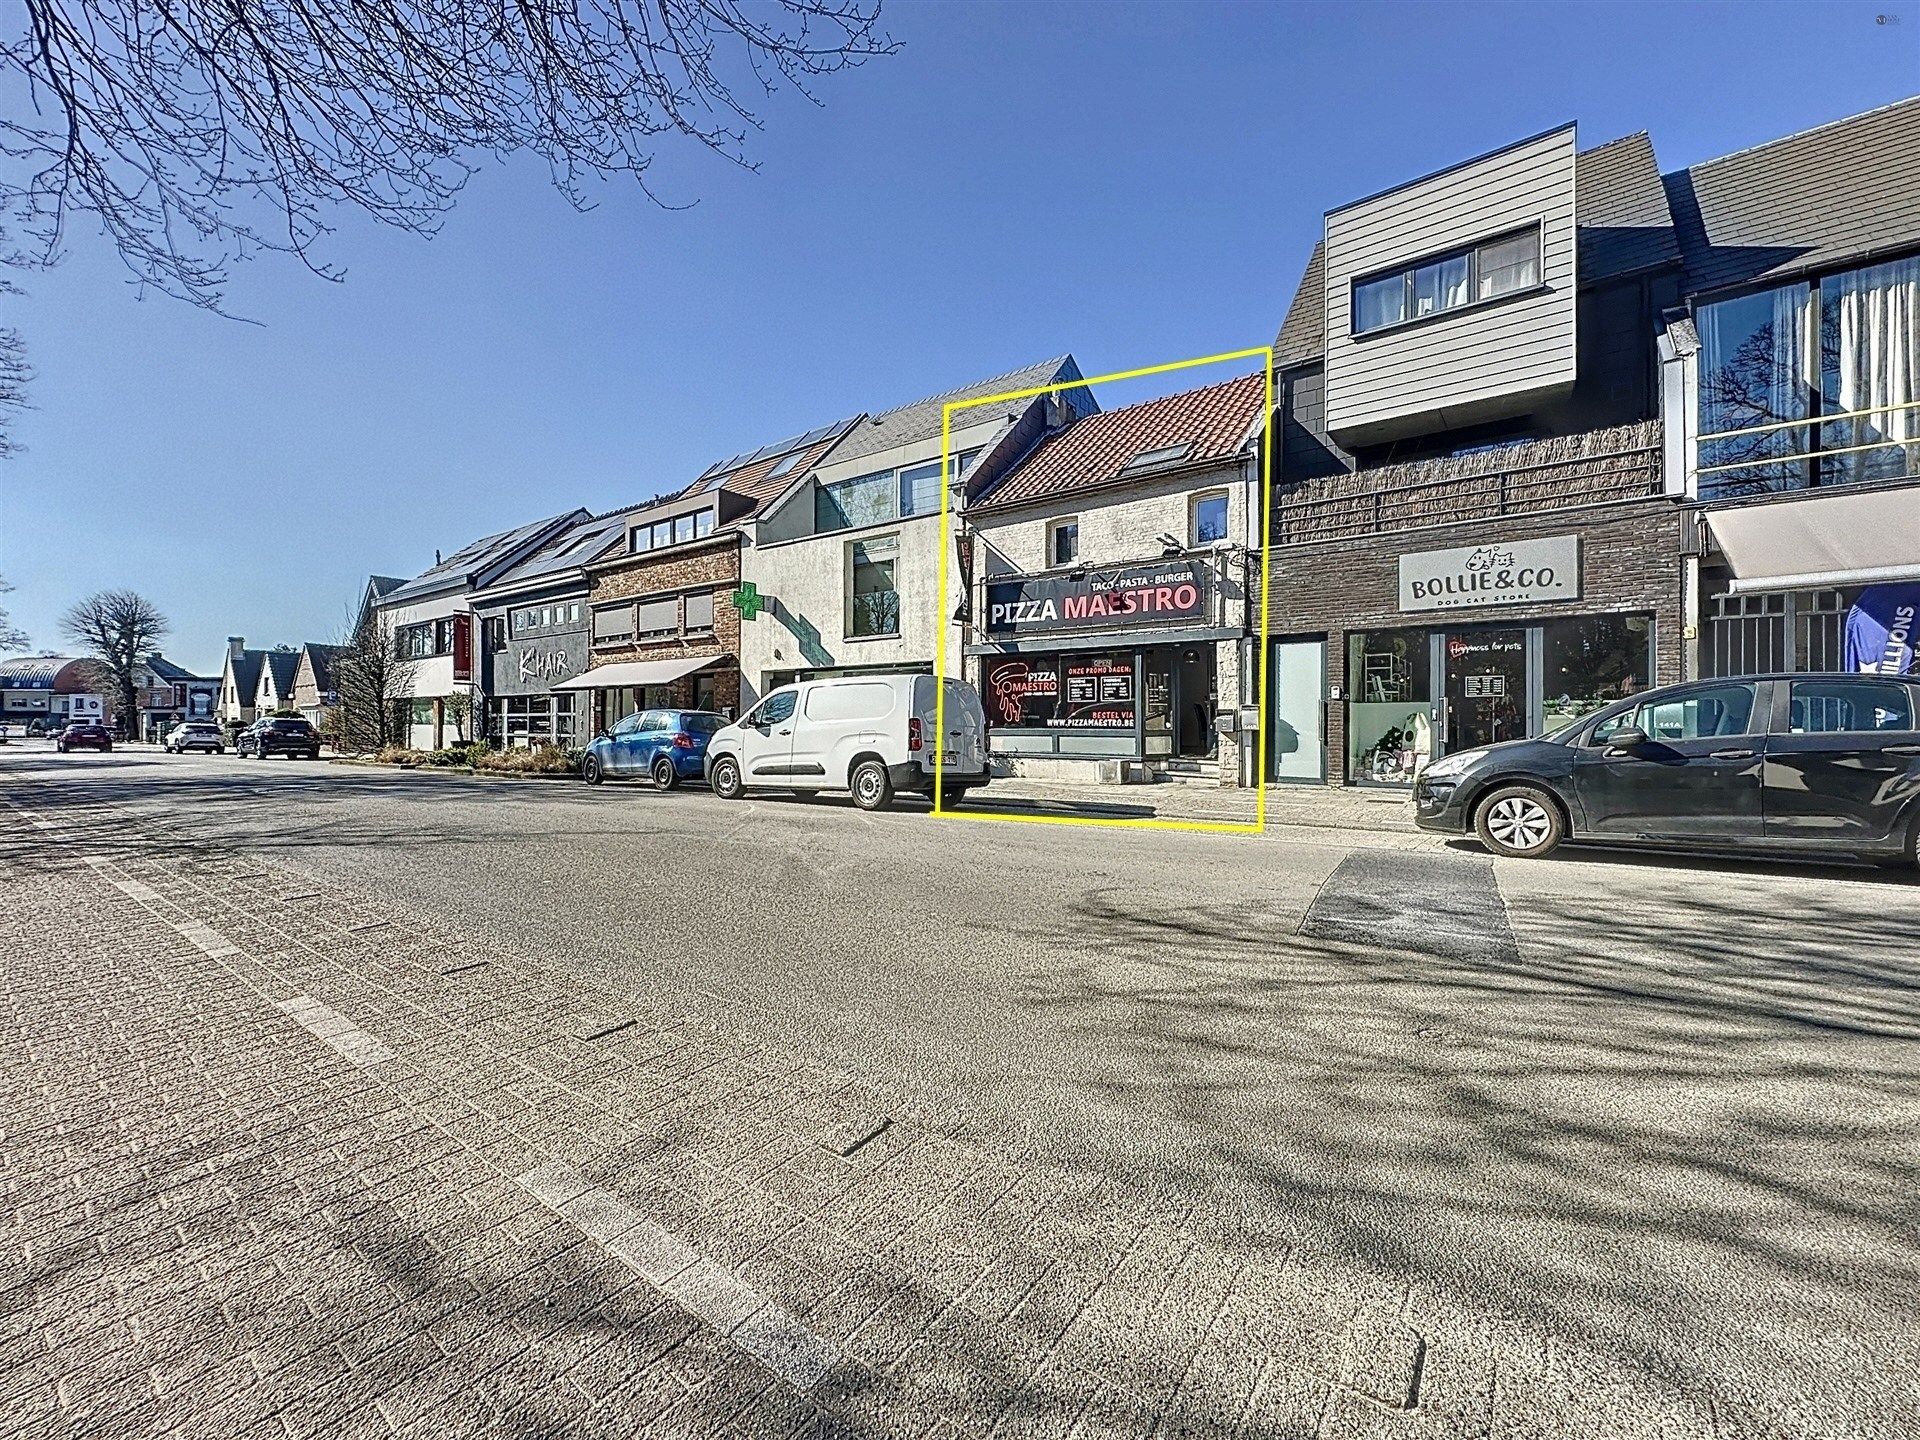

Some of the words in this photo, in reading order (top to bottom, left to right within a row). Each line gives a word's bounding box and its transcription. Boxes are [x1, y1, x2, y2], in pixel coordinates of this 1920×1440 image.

[1091, 581, 1115, 592] TACO
[1120, 578, 1148, 588] PASTA
[1155, 572, 1194, 585] BURGER
[1411, 568, 1563, 599] BOLLIE&CO.
[1493, 594, 1531, 602] STORE
[991, 599, 1058, 625] PIZZA
[1064, 584, 1198, 619] MAESTRO
[1880, 606, 1914, 675] ILLIONS
[1068, 667, 1085, 675] ONZE
[1028, 671, 1057, 682] PIZZA
[1012, 682, 1057, 691] MAESTRO
[1092, 711, 1120, 719] BESTEL
[1121, 711, 1134, 719] VIA
[1046, 718, 1135, 727] WWW.PIZZAMAESTRO.BE
